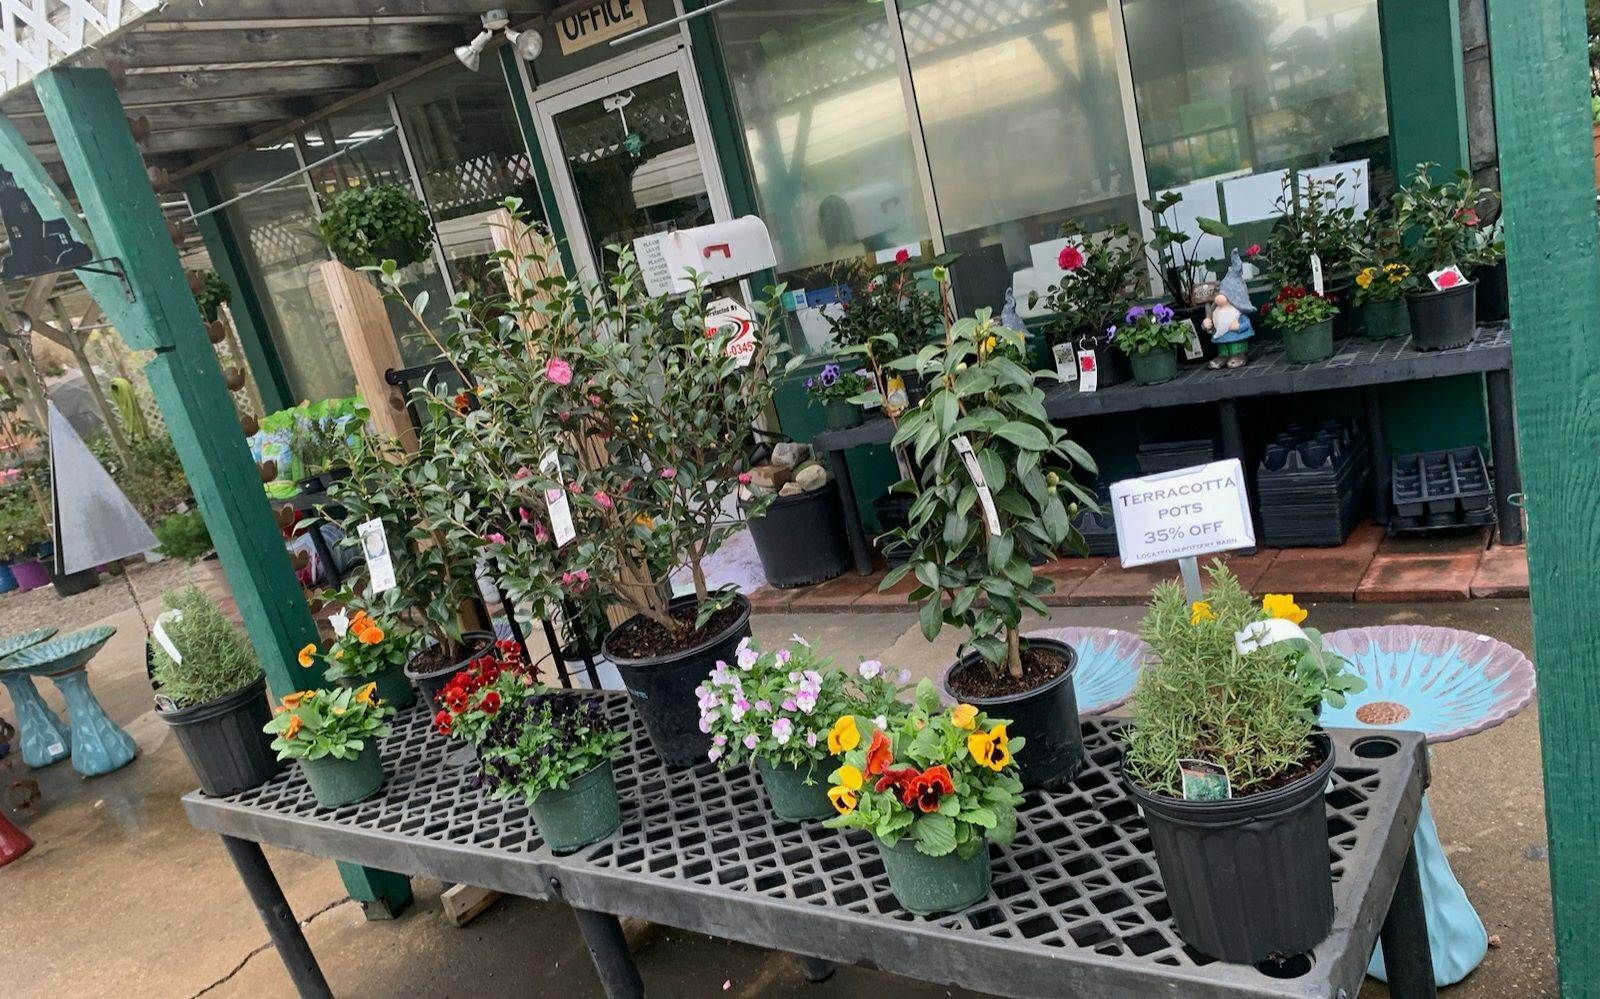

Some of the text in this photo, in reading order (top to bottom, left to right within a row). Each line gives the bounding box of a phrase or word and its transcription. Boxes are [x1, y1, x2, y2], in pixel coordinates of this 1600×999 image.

[562, 0, 634, 40] OFFICE
[1119, 477, 1236, 507] TERRACOTTA
[1158, 502, 1203, 520] POTS
[1144, 521, 1223, 544] 35% OFF
